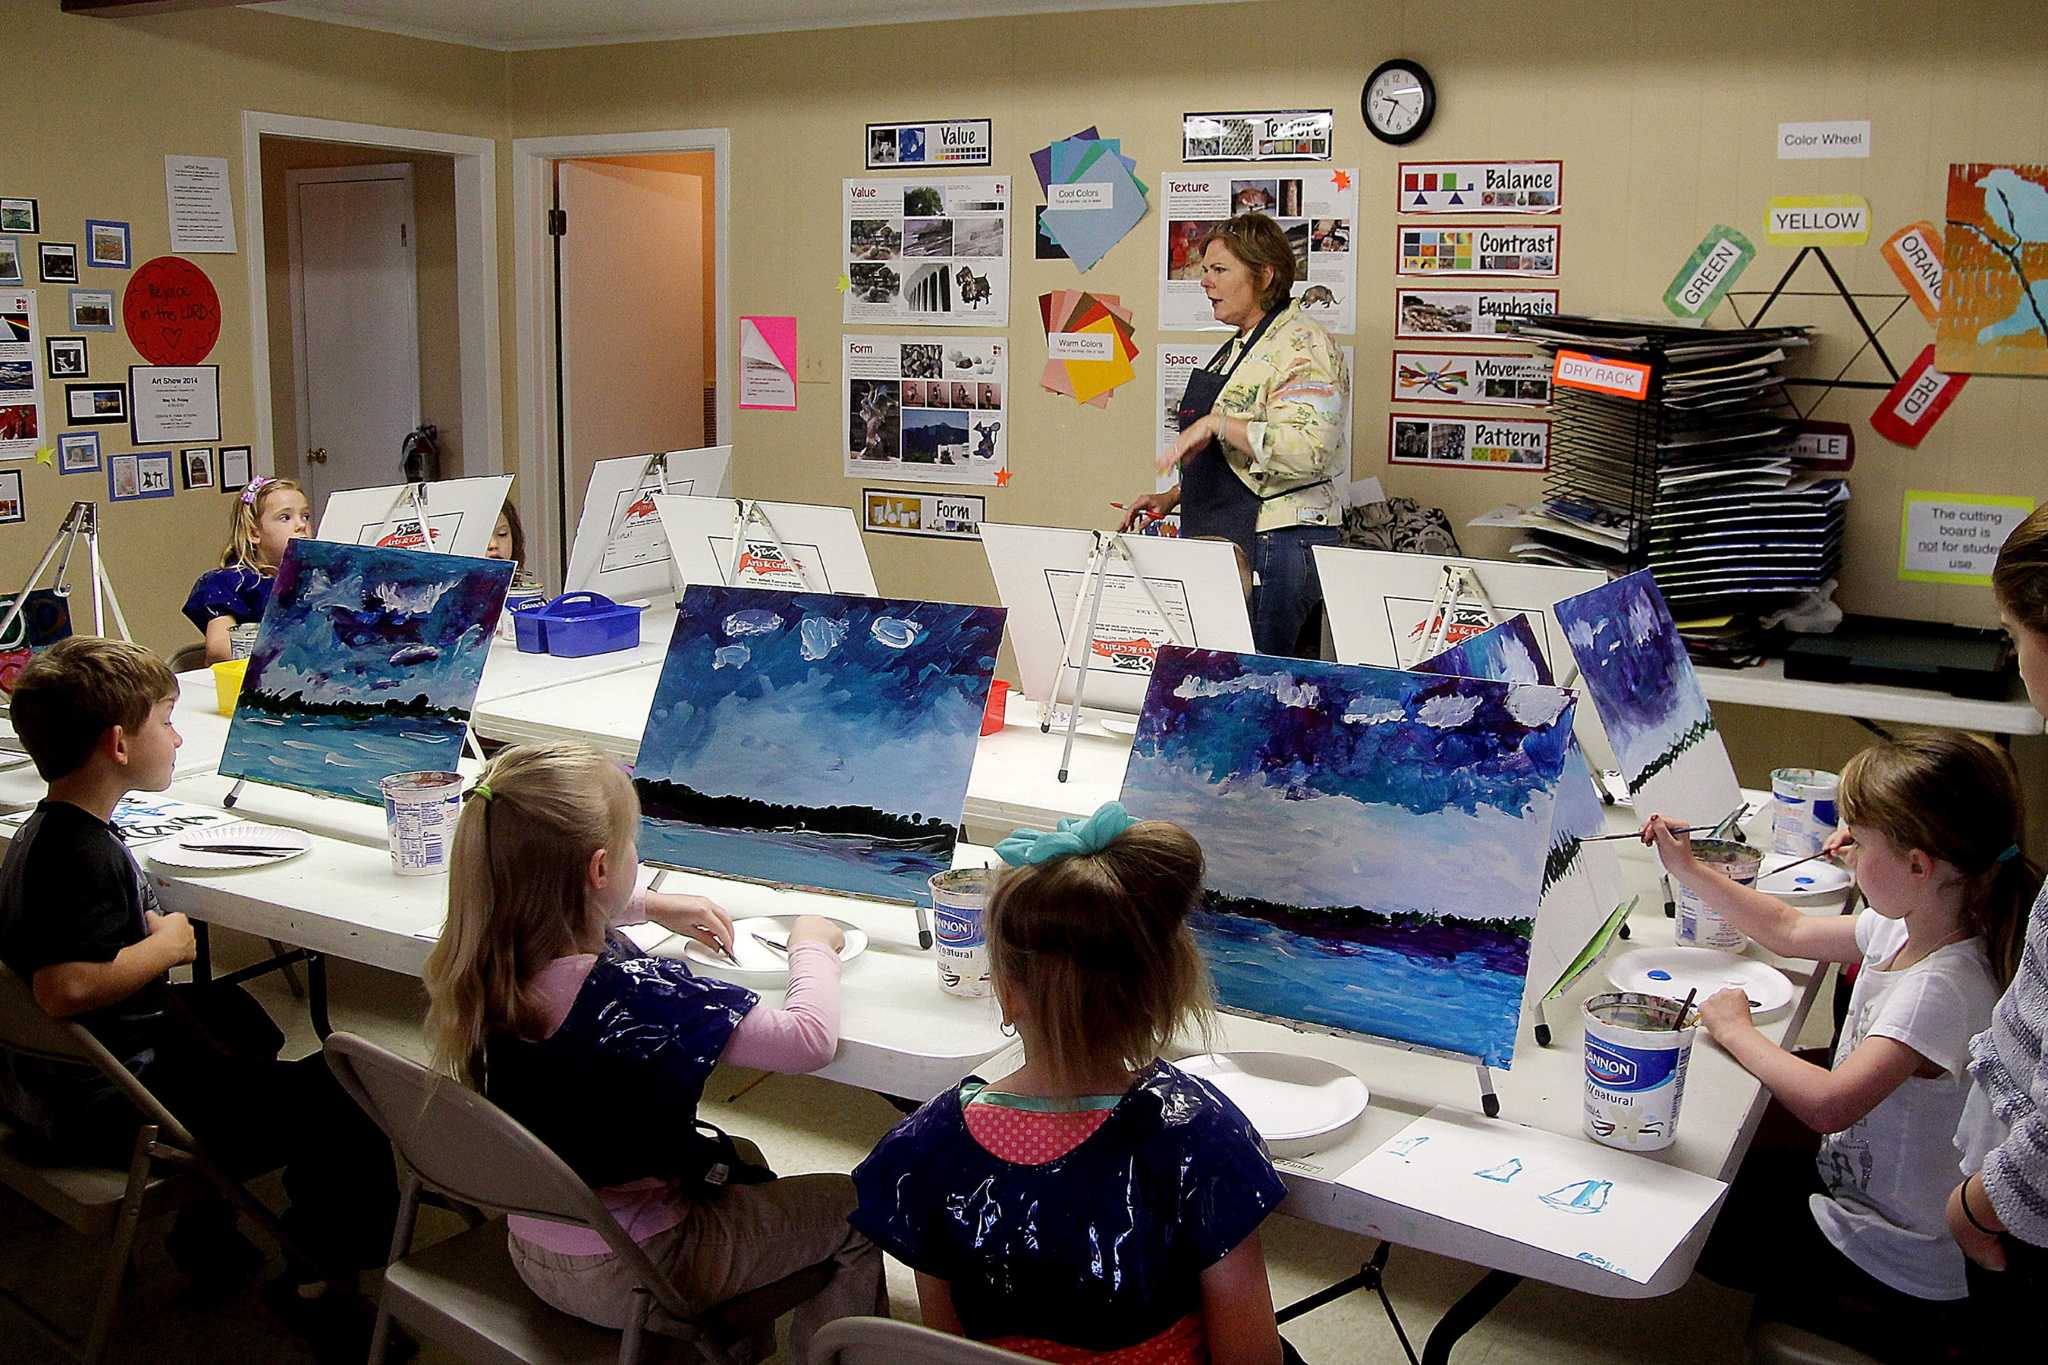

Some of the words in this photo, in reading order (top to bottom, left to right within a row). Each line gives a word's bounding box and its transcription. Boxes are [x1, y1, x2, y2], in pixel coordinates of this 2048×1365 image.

[941, 127, 976, 145] Value
[1264, 118, 1322, 137] Teure
[1784, 134, 1818, 146] Color
[1822, 133, 1862, 145] Wheel
[1169, 181, 1210, 193] Texture
[1486, 169, 1553, 189] Balance
[850, 187, 876, 198] Value
[1058, 190, 1075, 198] Cool
[1076, 189, 1099, 198] Colors
[1776, 212, 1860, 230] YELLOW
[1480, 232, 1555, 253] Contrast
[1683, 246, 1734, 306] GREEN
[1902, 236, 1942, 300] ORAN
[1478, 296, 1553, 320] Emphasis
[850, 343, 873, 354] Form
[1059, 339, 1079, 348] Warm
[1080, 340, 1103, 348] Colors
[1164, 352, 1198, 367] Space
[1563, 363, 1592, 377] DRY
[1595, 368, 1635, 385] RACK
[1904, 376, 1938, 415] RED
[1475, 424, 1541, 447] Pattern
[936, 500, 970, 519] Form
[1932, 507, 1956, 519] The
[1959, 511, 2002, 525] cutting
[1940, 526, 1977, 538] board
[1981, 527, 1991, 538] is
[1919, 541, 1938, 552] not
[1942, 540, 1959, 552] for
[1962, 543, 1999, 554] stude
[1594, 1088, 1634, 1107] natural
